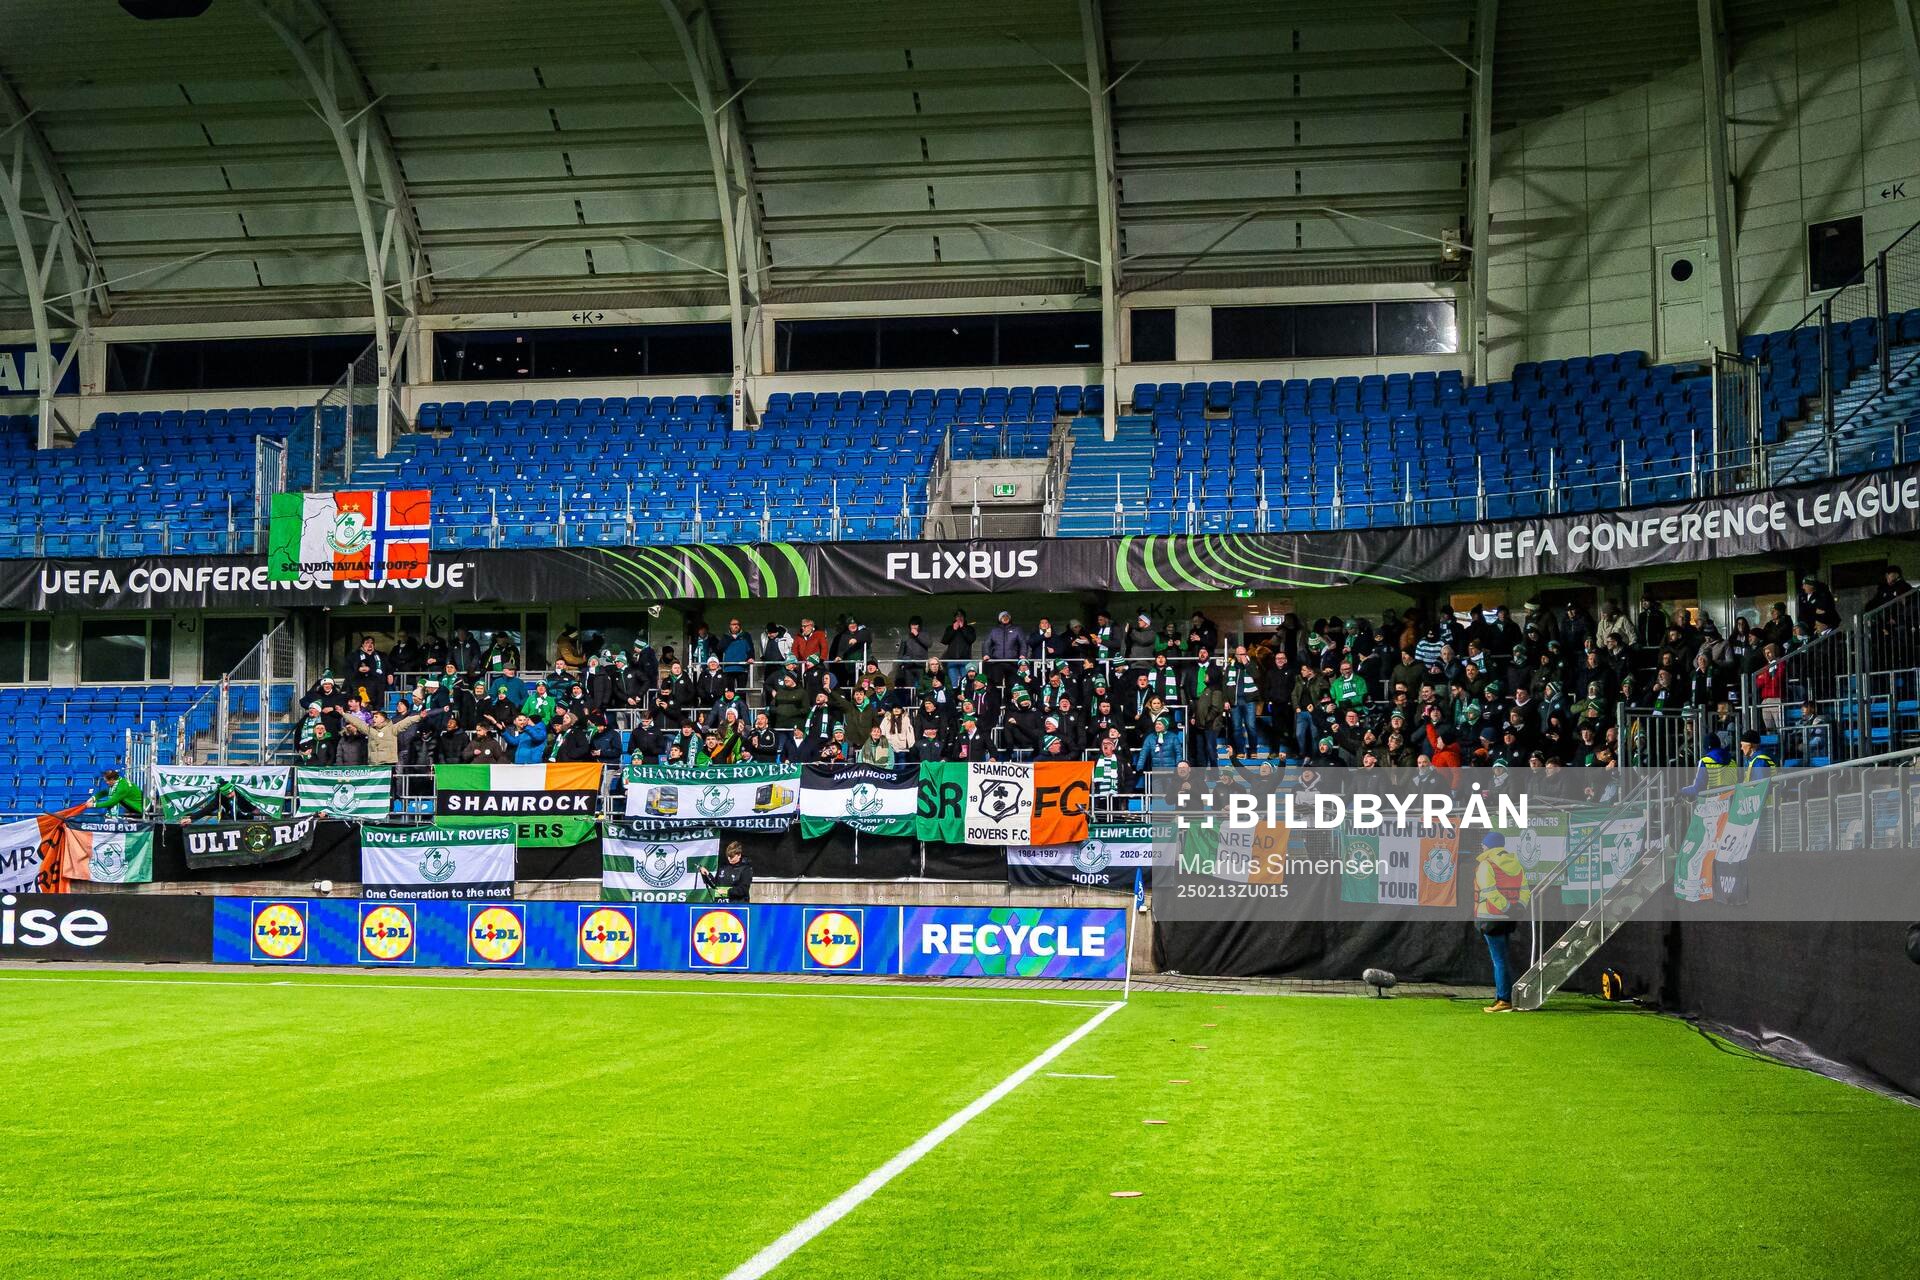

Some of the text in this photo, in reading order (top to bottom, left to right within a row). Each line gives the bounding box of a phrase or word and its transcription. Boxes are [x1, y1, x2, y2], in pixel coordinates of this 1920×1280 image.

[1893, 182, 1906, 200] K
[582, 311, 593, 324] K
[1468, 477, 1919, 562] UEFA CONFERENCE LEAGUE
[280, 560, 419, 572] SCANDINAVIAN HOOPS
[40, 569, 121, 594] UEFA
[1150, 602, 1165, 618] K
[344, 769, 371, 777] GOVAN
[633, 761, 798, 780] SHAMROCK ROVERS
[833, 769, 898, 780] NAVAN HOOPS
[972, 763, 1030, 779] SHAMROCK
[448, 795, 590, 811] SHAMROCK
[917, 778, 963, 819] SR
[969, 795, 978, 803] 18
[1034, 780, 1089, 818] FC
[735, 817, 790, 829] BERLIN
[846, 819, 878, 832] ICTORY
[1417, 820, 1457, 840] BOYS
[366, 828, 510, 843] DOYLE FAMILY ROVERS
[967, 828, 1030, 841] ROVERS F.C.
[1094, 827, 1172, 839] TEMPLEOGUE
[188, 830, 241, 854] ULT
[1017, 849, 1059, 858] 1984-1987
[1119, 850, 1163, 859] 2020-2023
[1389, 850, 1409, 868] ON
[1071, 873, 1110, 885] HOOPS
[366, 886, 511, 899] One Generation to the next
[631, 891, 687, 903] HOOPS
[1379, 881, 1418, 899] TOUR
[1, 894, 109, 947] ise
[921, 923, 1105, 957] RECYCLE
